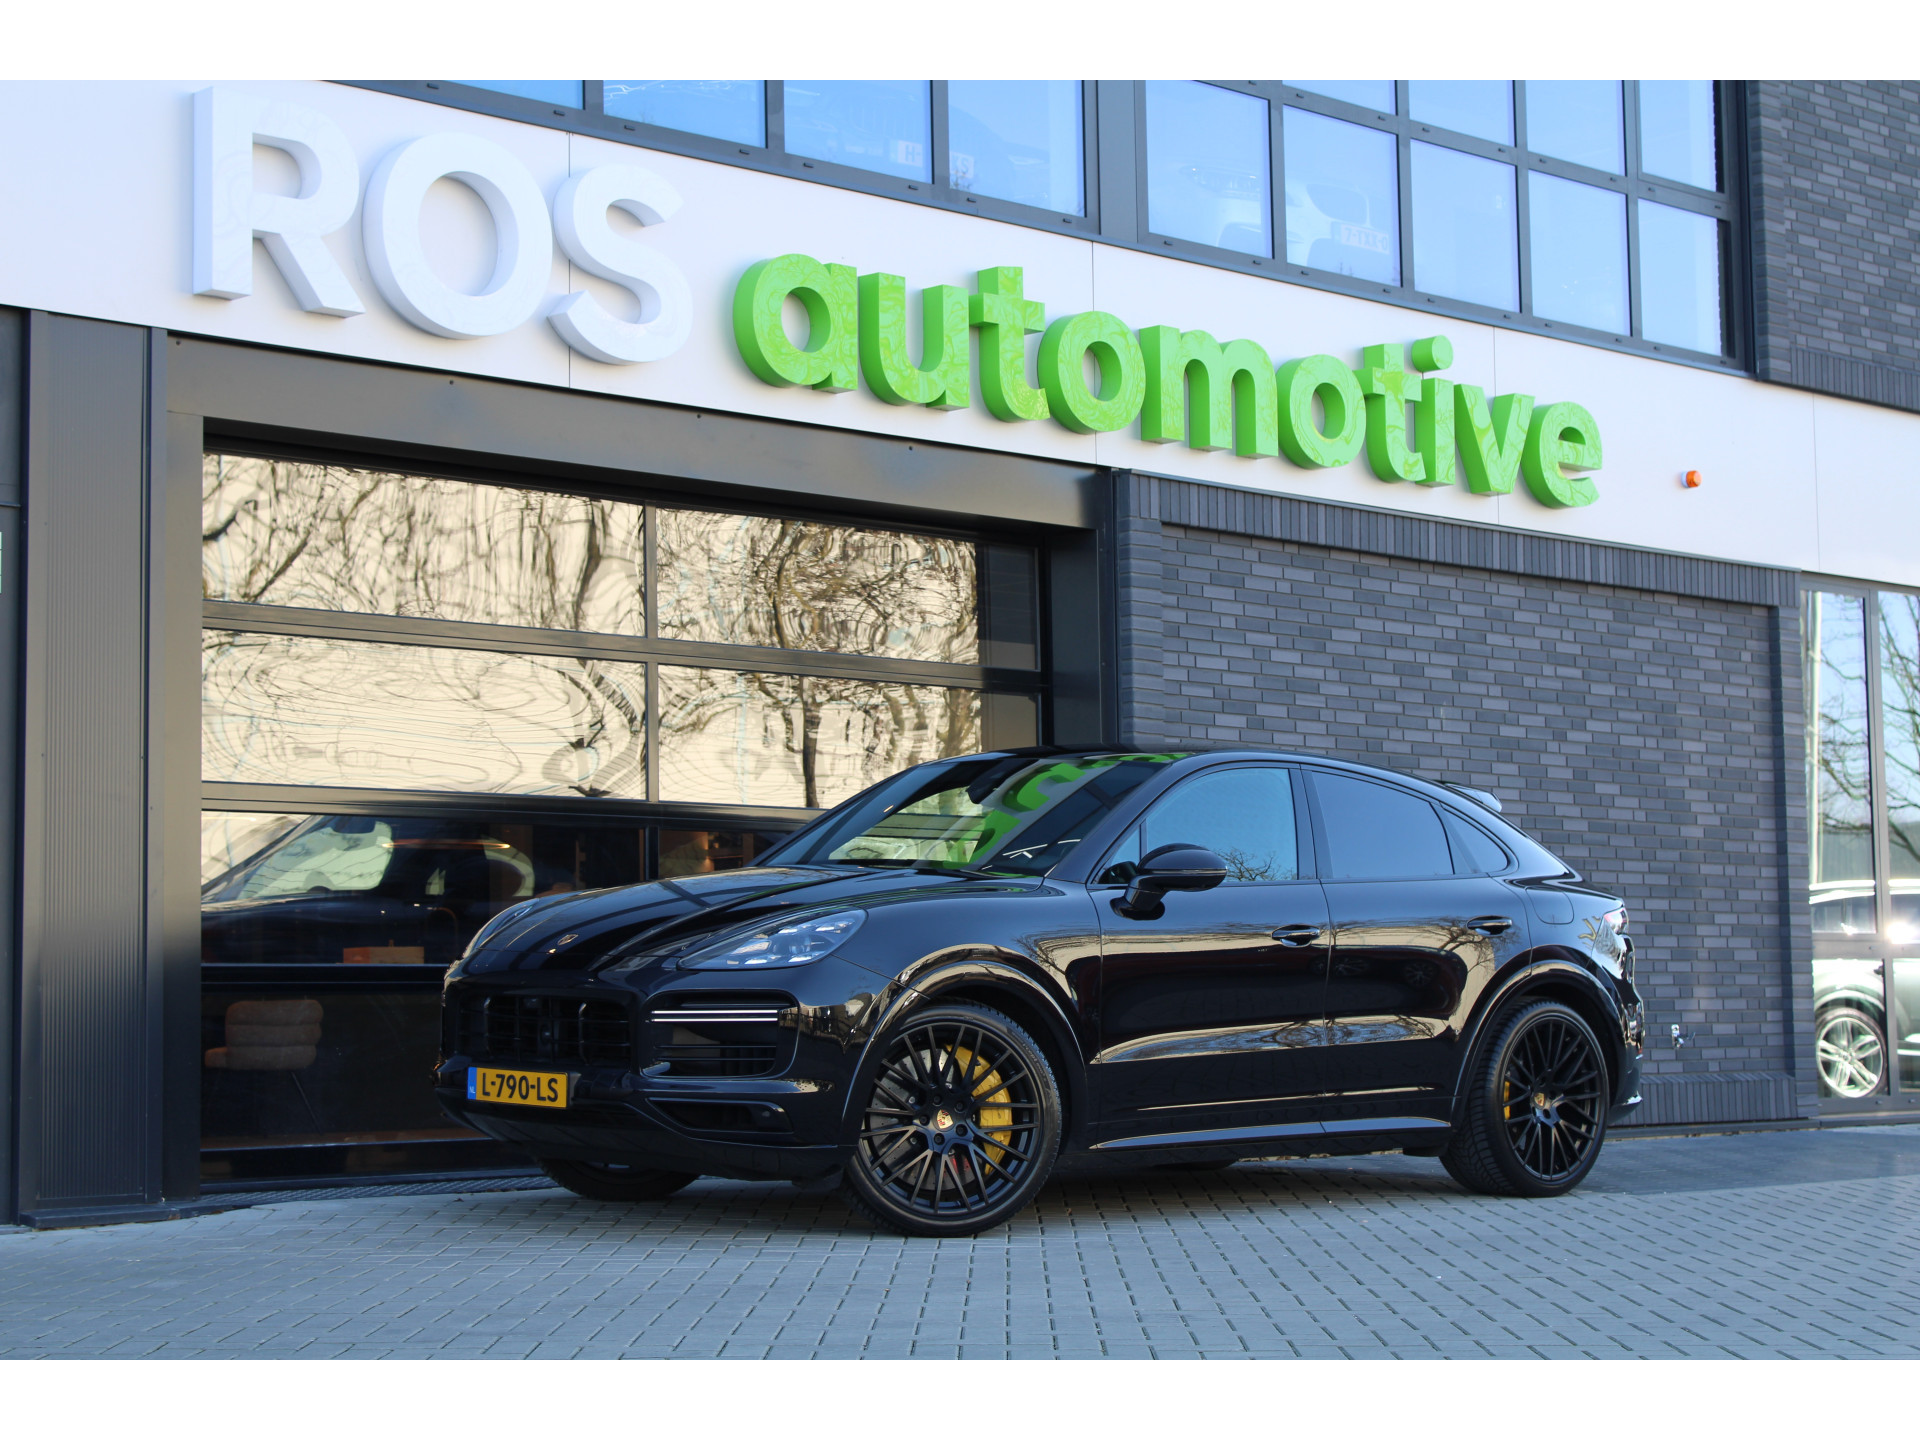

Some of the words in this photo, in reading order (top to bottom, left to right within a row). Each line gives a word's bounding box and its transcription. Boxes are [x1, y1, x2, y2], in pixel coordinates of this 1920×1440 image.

[194, 86, 694, 365] ROS
[732, 253, 1603, 509] automotive
[482, 1072, 559, 1103] L-790-LS
